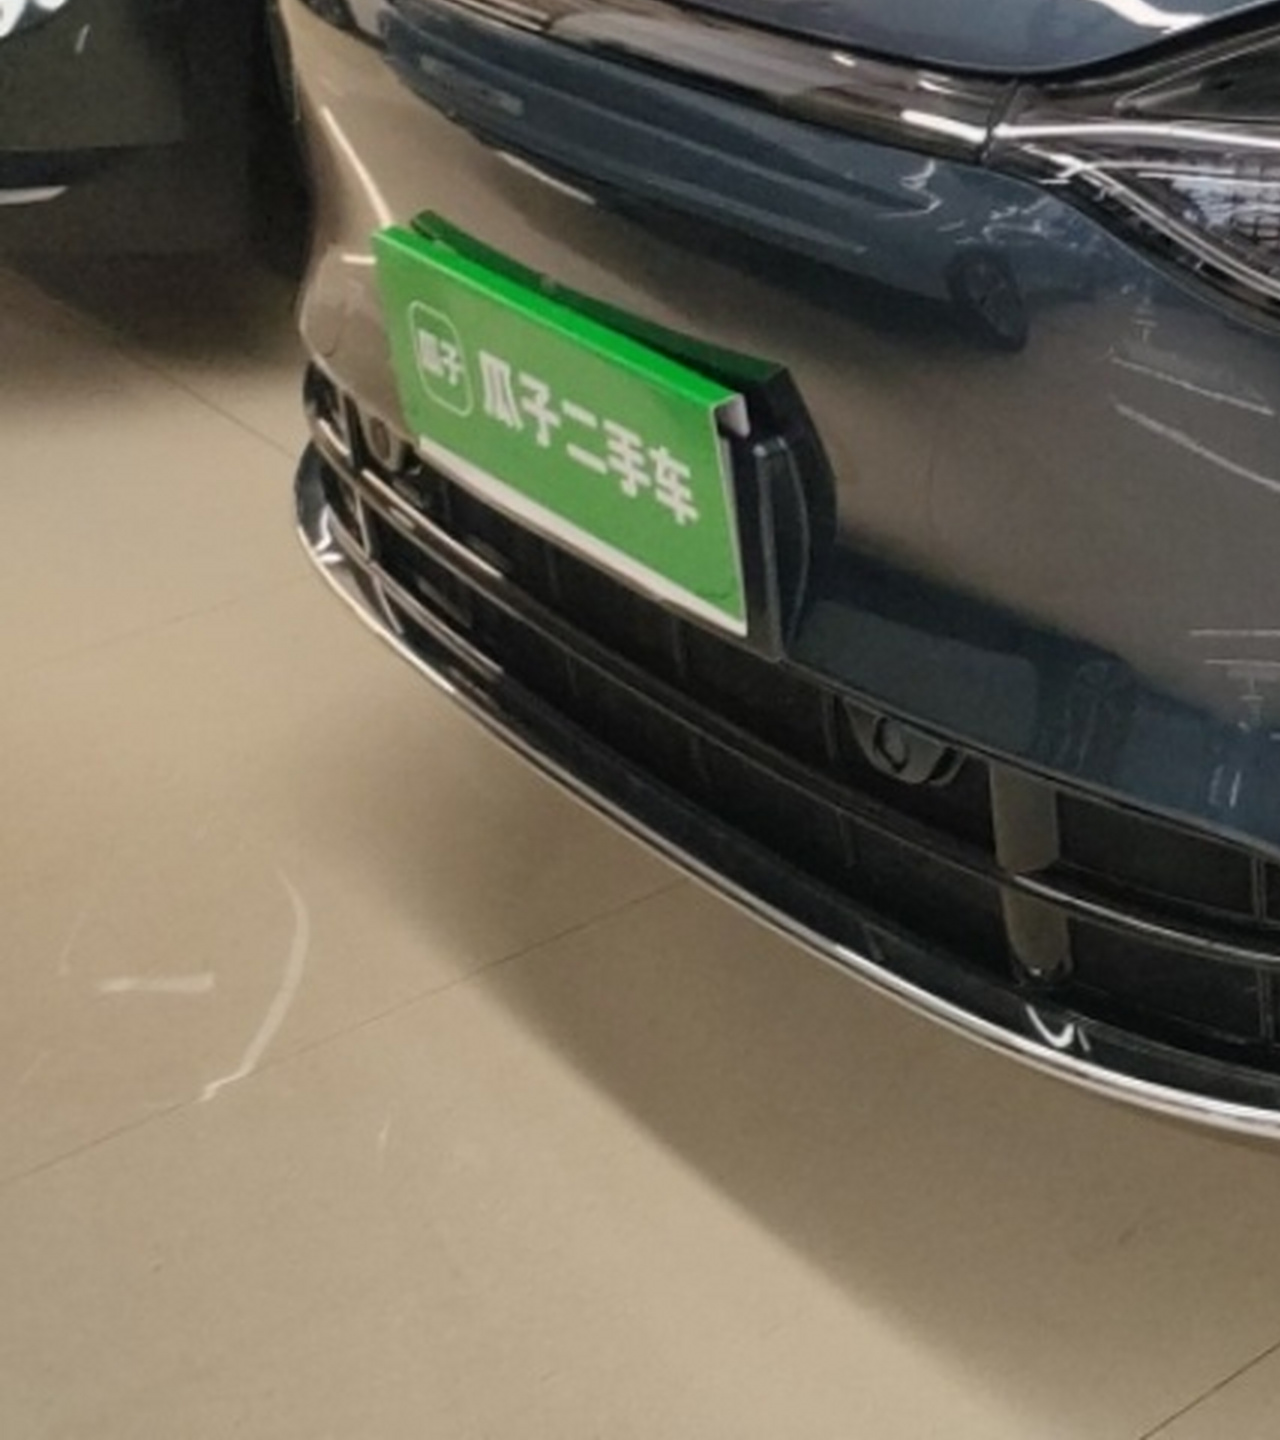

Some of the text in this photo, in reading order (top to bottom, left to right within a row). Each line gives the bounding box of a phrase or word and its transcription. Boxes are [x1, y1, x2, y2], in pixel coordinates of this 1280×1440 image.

[478, 349, 700, 527] 瓜子二手车
